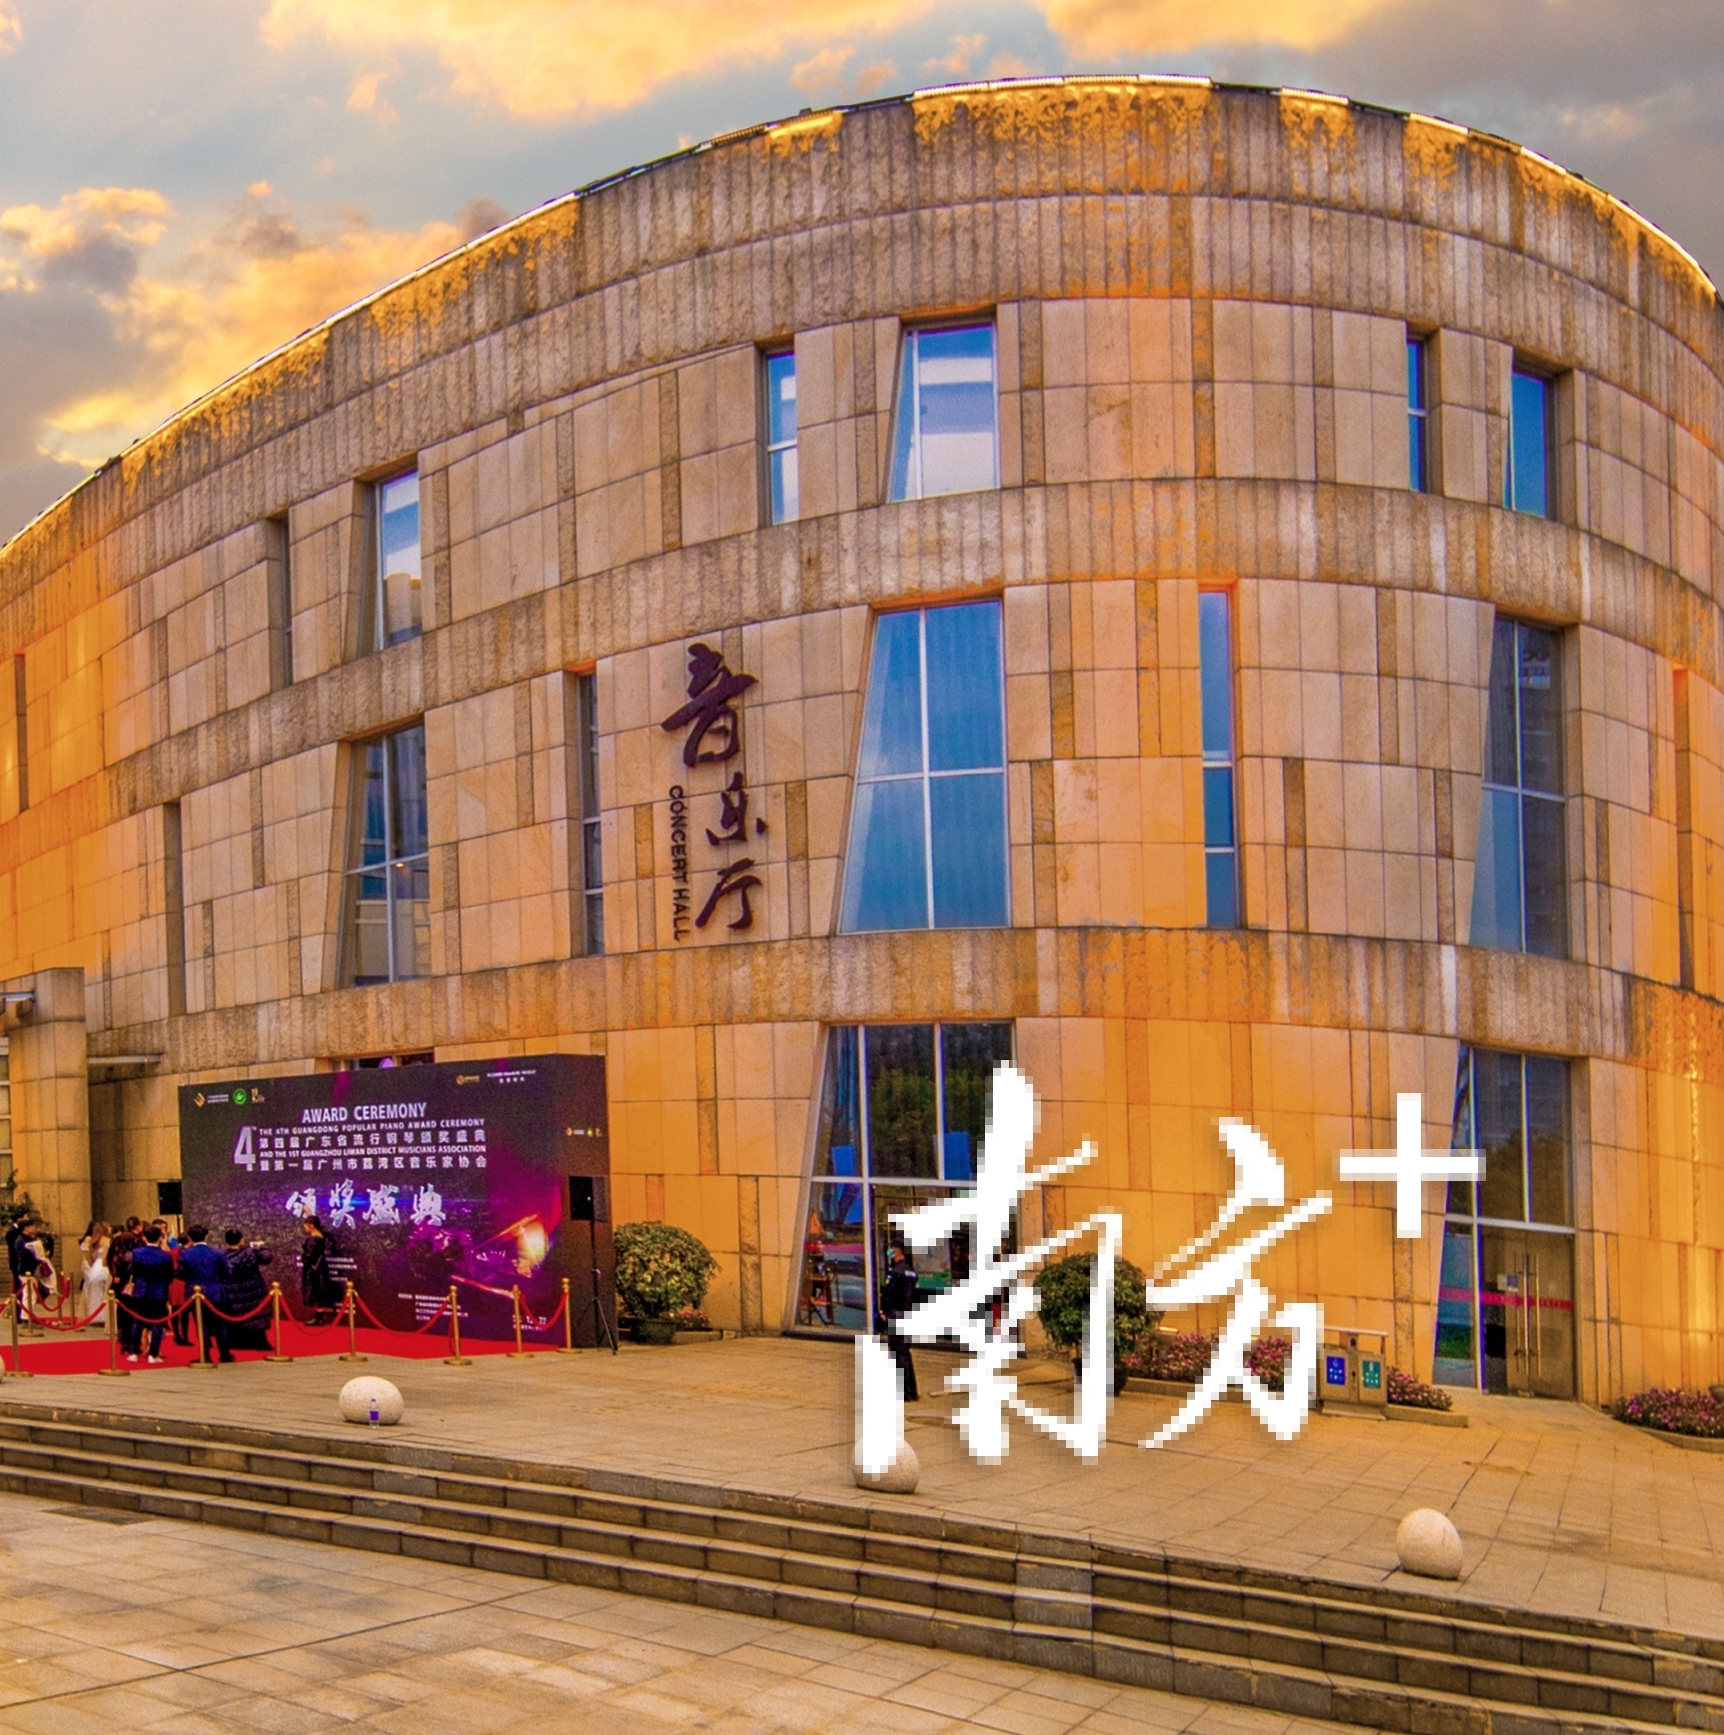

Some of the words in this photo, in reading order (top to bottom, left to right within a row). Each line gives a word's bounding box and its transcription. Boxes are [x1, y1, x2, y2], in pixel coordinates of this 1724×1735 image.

[660, 643, 768, 930] 音乐厅
[669, 785, 689, 884] CONCERT
[672, 888, 690, 941] HALL
[259, 1128, 272, 1136] THE
[275, 1127, 289, 1135] 4TH
[292, 1125, 339, 1134] GUANGDONG
[342, 1123, 376, 1132] POPULAR
[380, 1121, 405, 1130] PIANO
[408, 1120, 437, 1129] AWARD
[440, 1118, 485, 1128] CEREMONY
[302, 1107, 348, 1124] AWARD
[354, 1102, 426, 1121] CEREMONY
[275, 1150, 287, 1158] THE
[301, 1148, 342, 1157] GUANGZHOU
[343, 1147, 365, 1156] LIWAN
[367, 1146, 396, 1155] DISTRICT
[398, 1145, 436, 1154] MUSICIANS
[438, 1144, 486, 1153] ASSOCIATION
